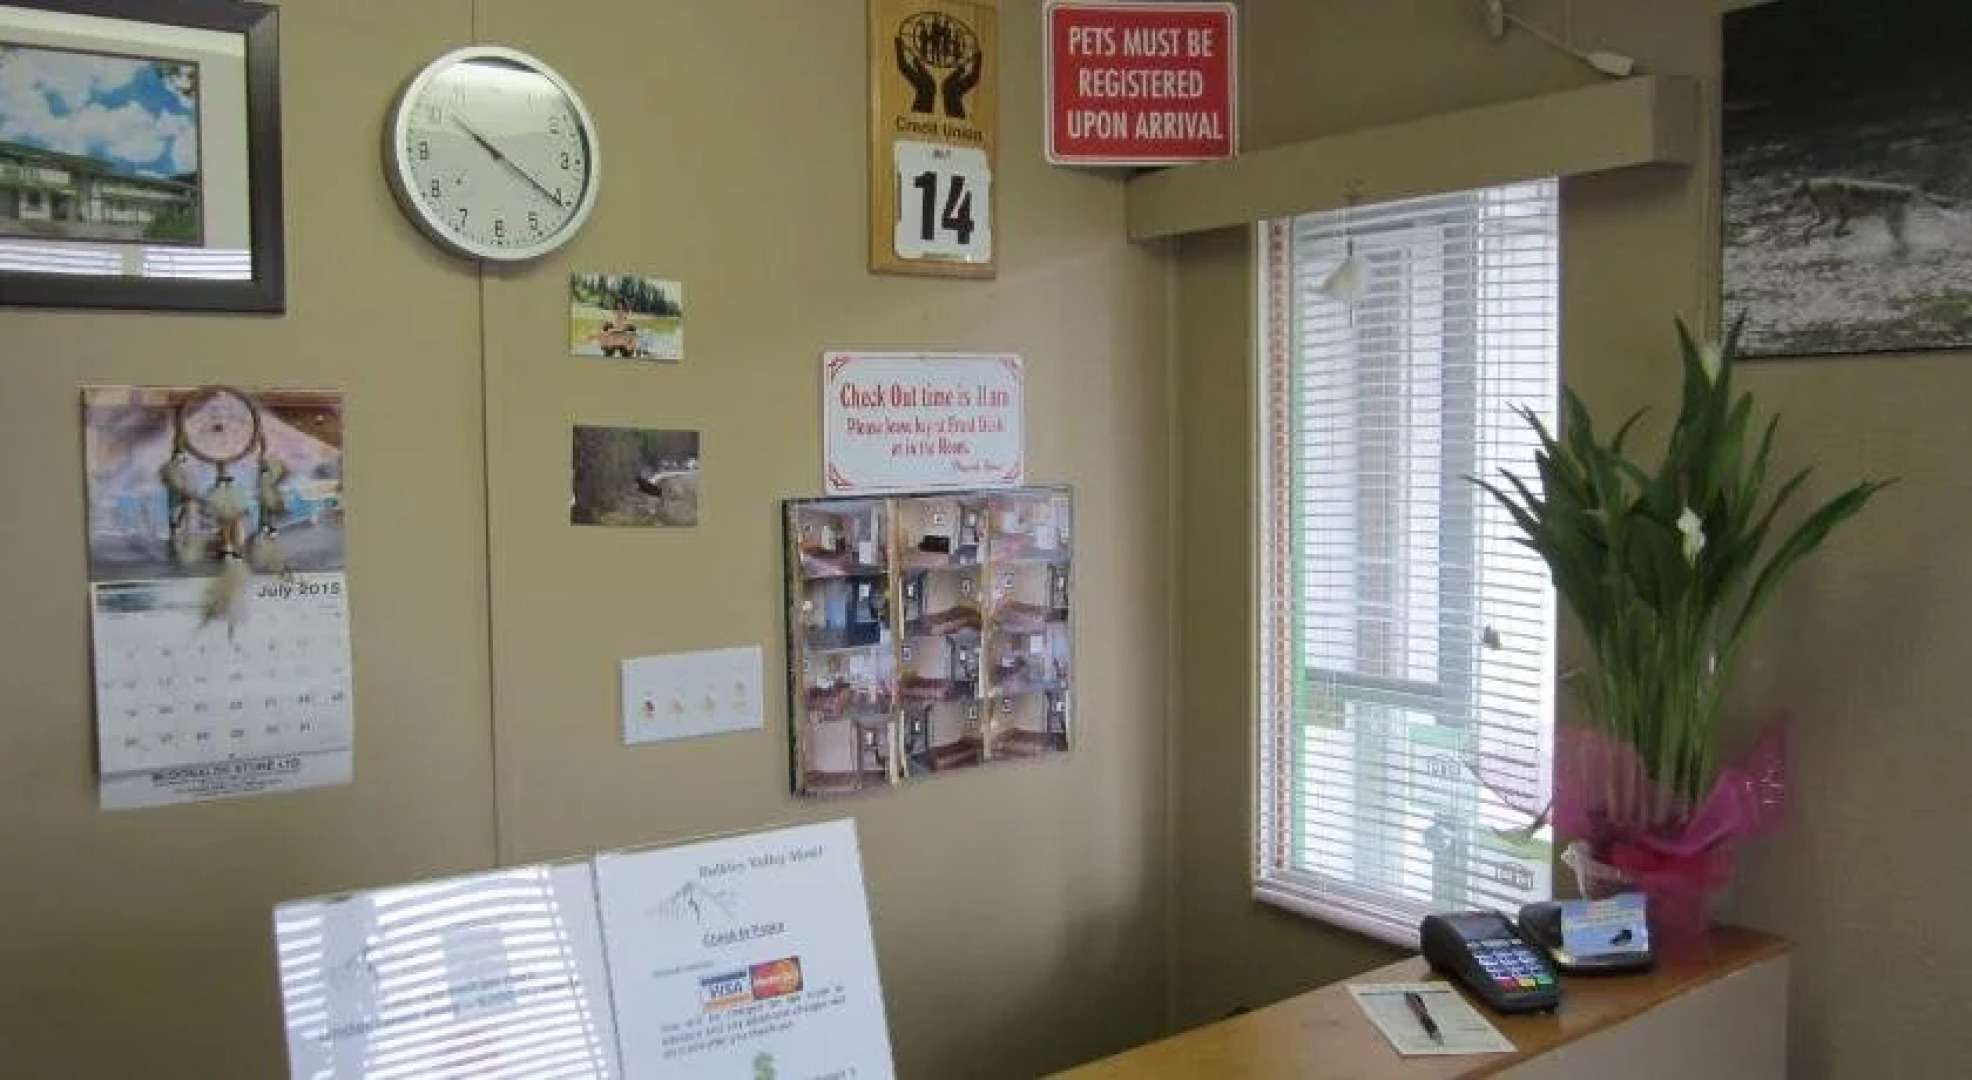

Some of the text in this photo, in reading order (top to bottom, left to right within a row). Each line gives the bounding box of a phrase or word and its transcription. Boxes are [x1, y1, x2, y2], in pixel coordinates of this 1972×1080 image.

[1068, 26, 1214, 57] PETS MUST BE
[1079, 68, 1203, 97] REGISTERED
[943, 123, 983, 142] Union
[1067, 110, 1224, 139] UPON ARRIVAL
[913, 171, 975, 244] 14
[840, 382, 886, 408] Check
[891, 382, 917, 408] Out
[922, 383, 953, 408] time
[257, 582, 340, 599] July 2015
[709, 981, 744, 998] VISA
